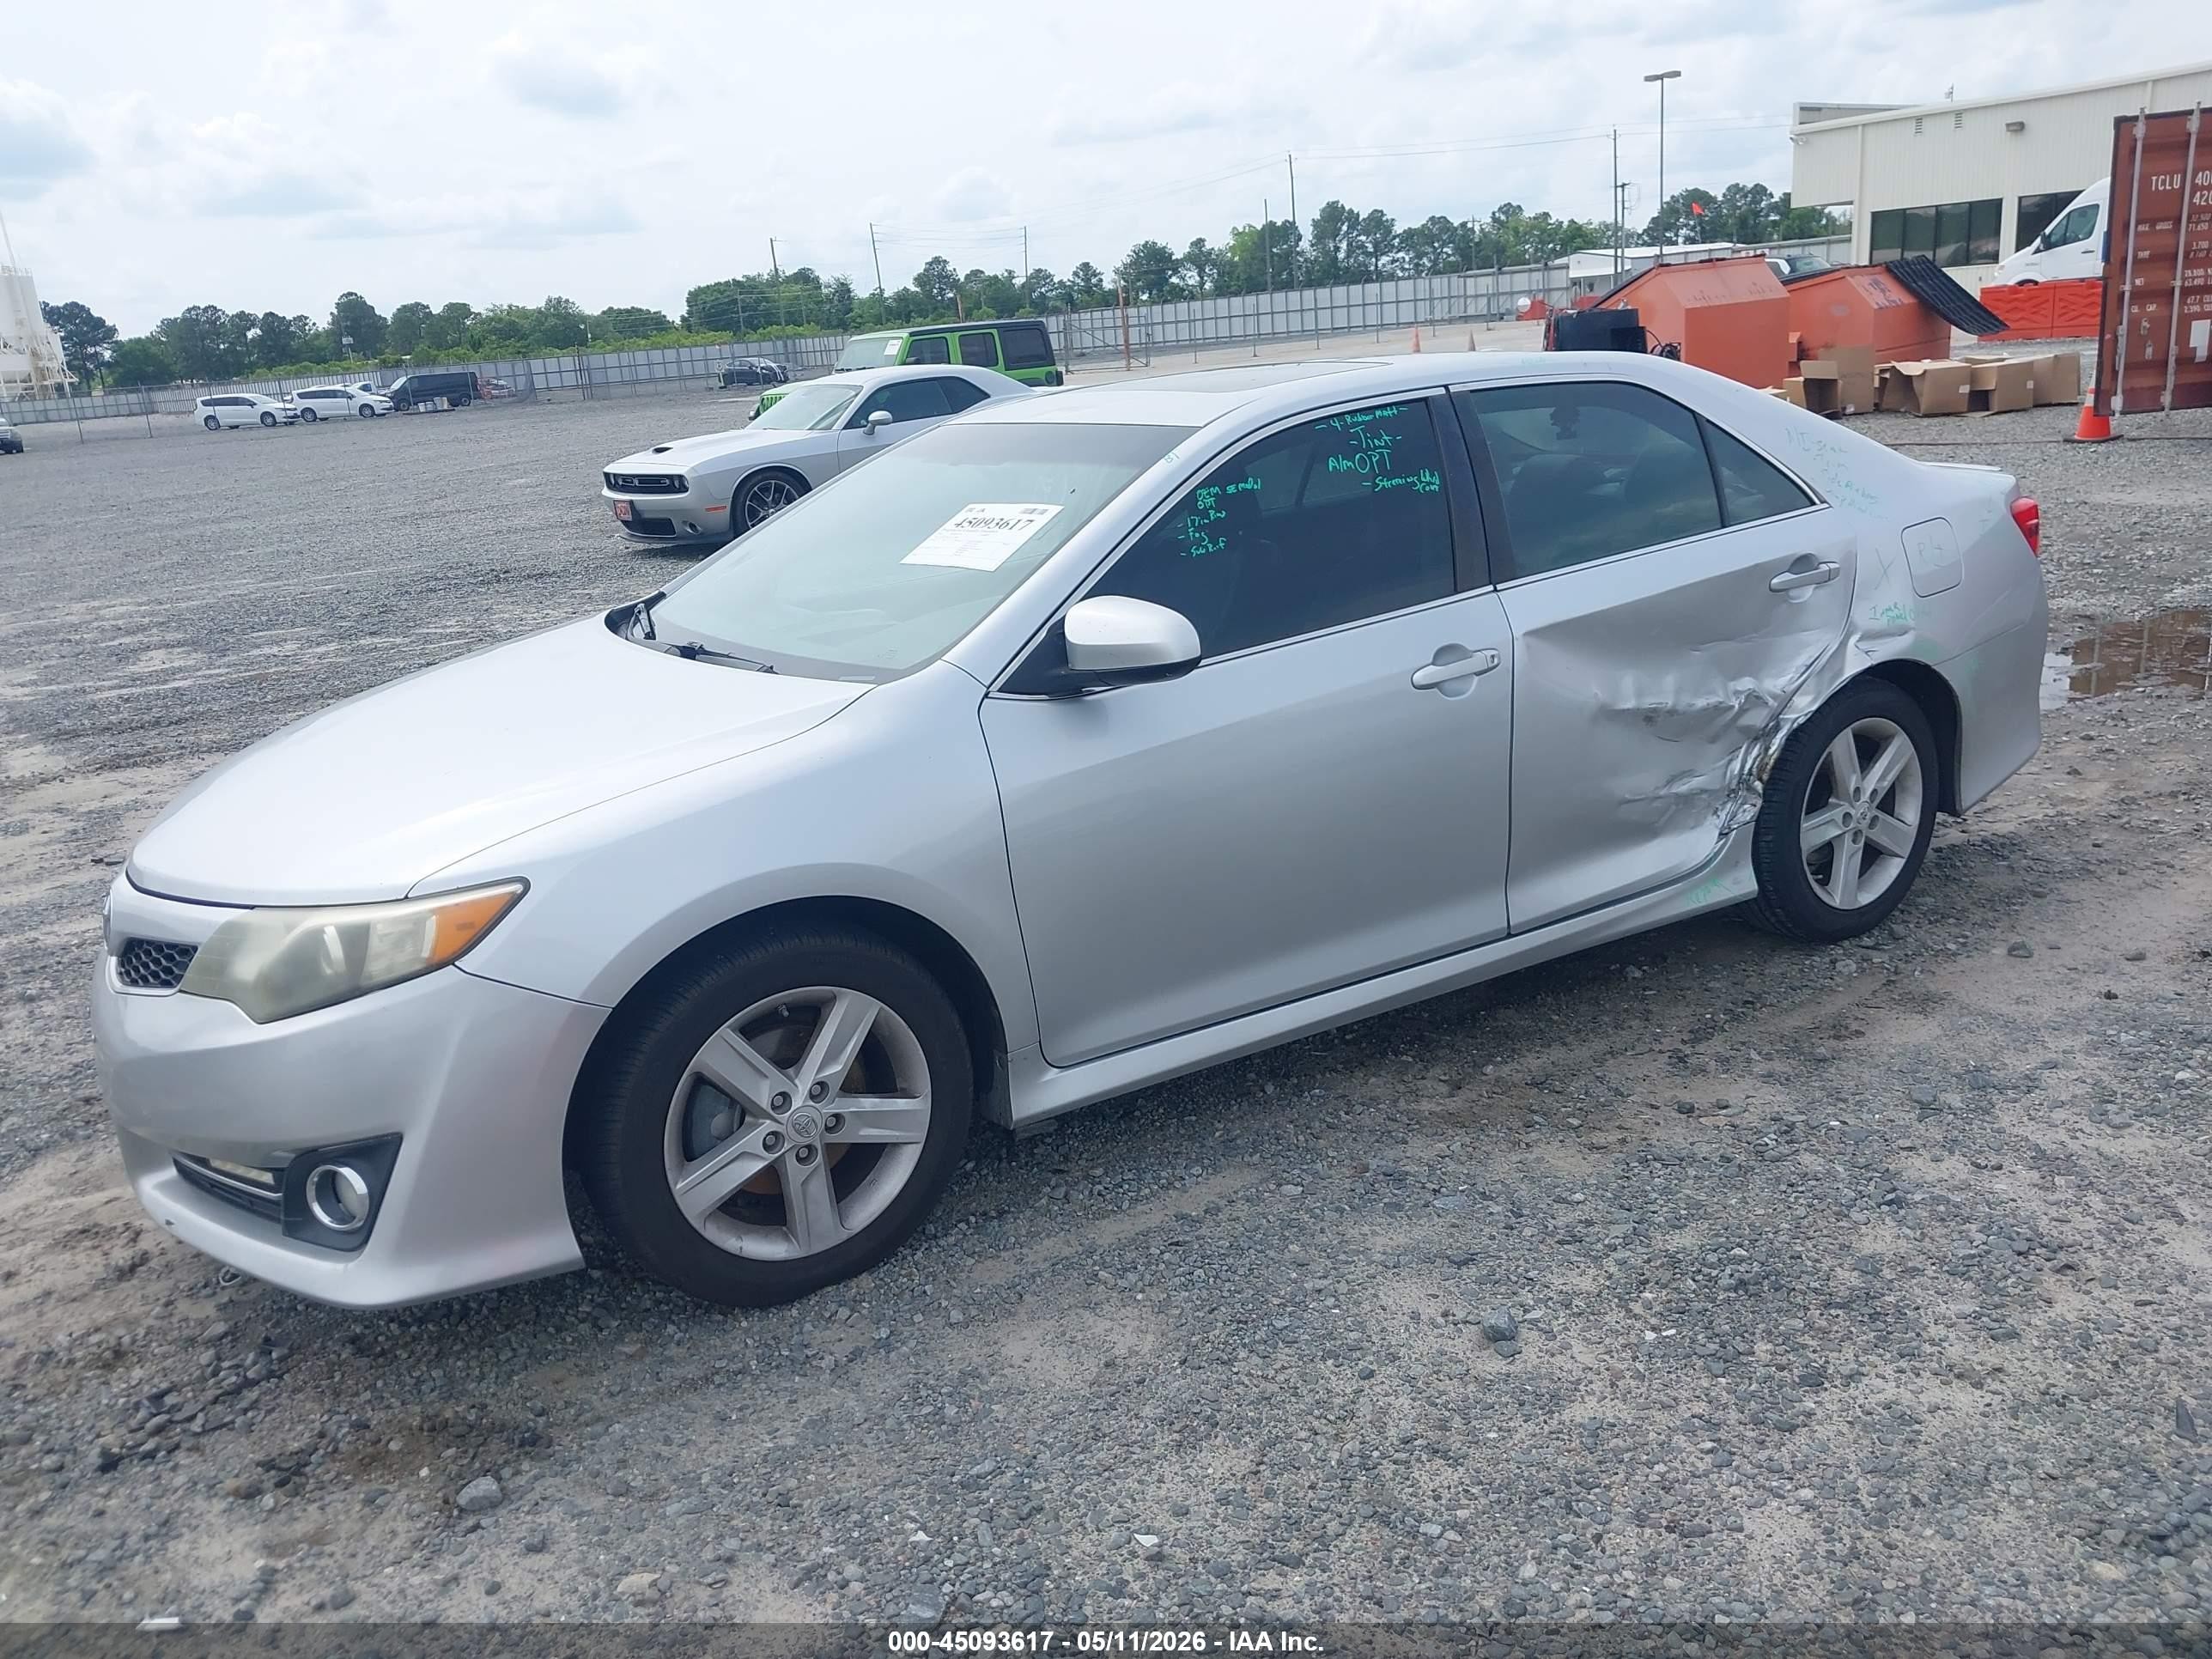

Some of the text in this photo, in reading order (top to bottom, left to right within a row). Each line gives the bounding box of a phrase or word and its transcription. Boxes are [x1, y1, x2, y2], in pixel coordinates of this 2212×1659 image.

[2151, 170, 2212, 191] TCLU 40
[1196, 486, 1221, 500] OEM
[1196, 498, 1216, 509] OPT
[953, 516, 1036, 532] 45093617
